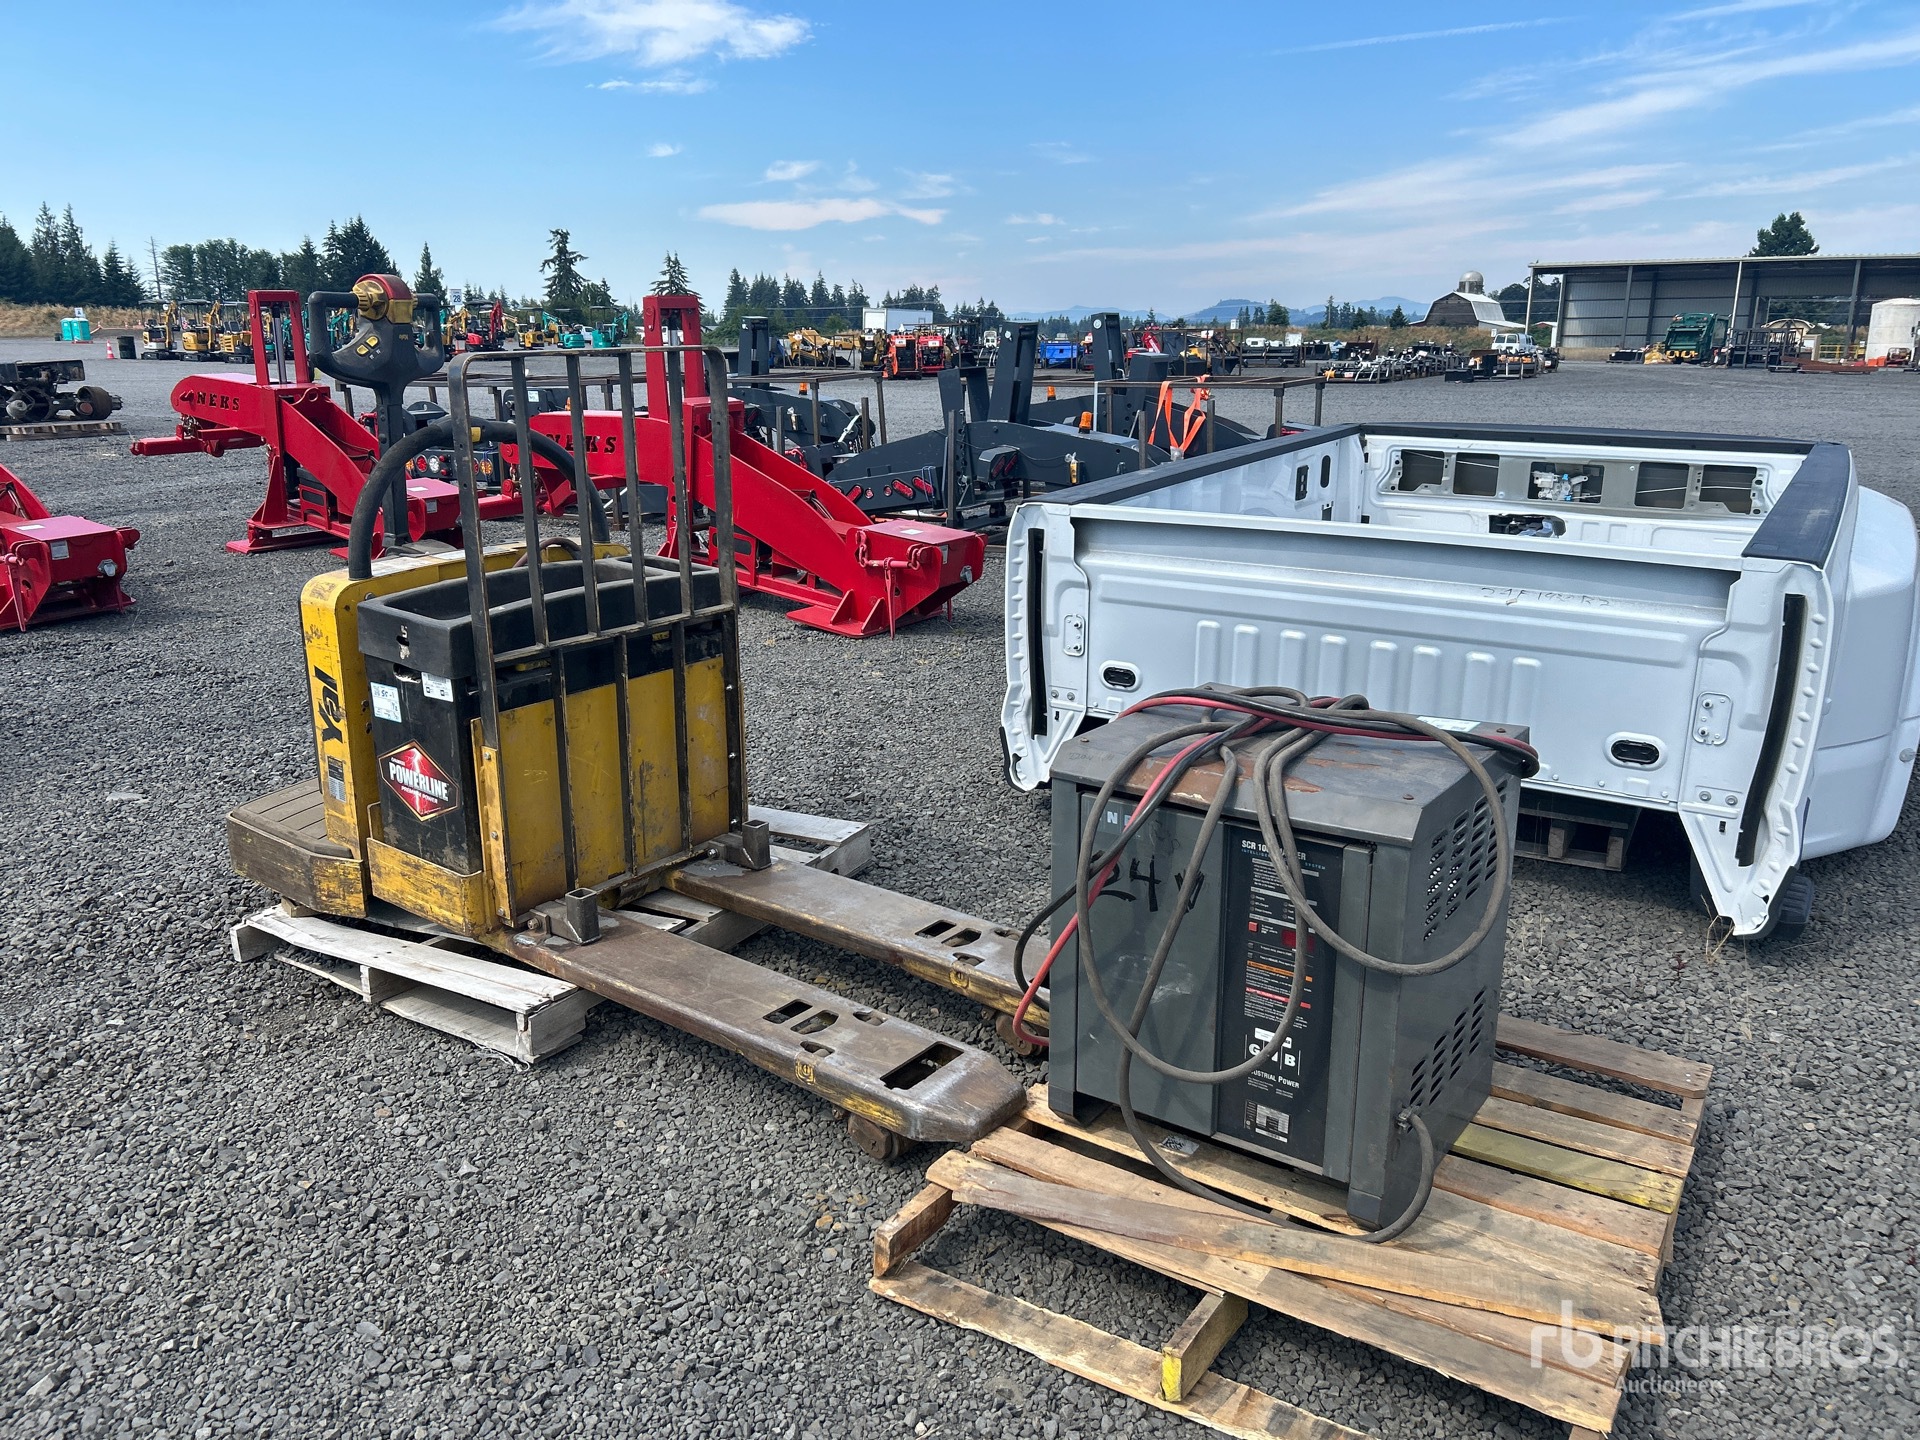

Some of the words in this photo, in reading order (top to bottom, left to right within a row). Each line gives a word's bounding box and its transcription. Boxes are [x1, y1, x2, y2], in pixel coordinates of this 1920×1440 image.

[453, 294, 462, 303] 28
[388, 761, 449, 802] POWERLINE
[422, 793, 438, 804] POWER
[1241, 839, 1256, 850] SCR
[1251, 1069, 1277, 1082] USTRIAL
[1278, 1075, 1300, 1089] POWER
